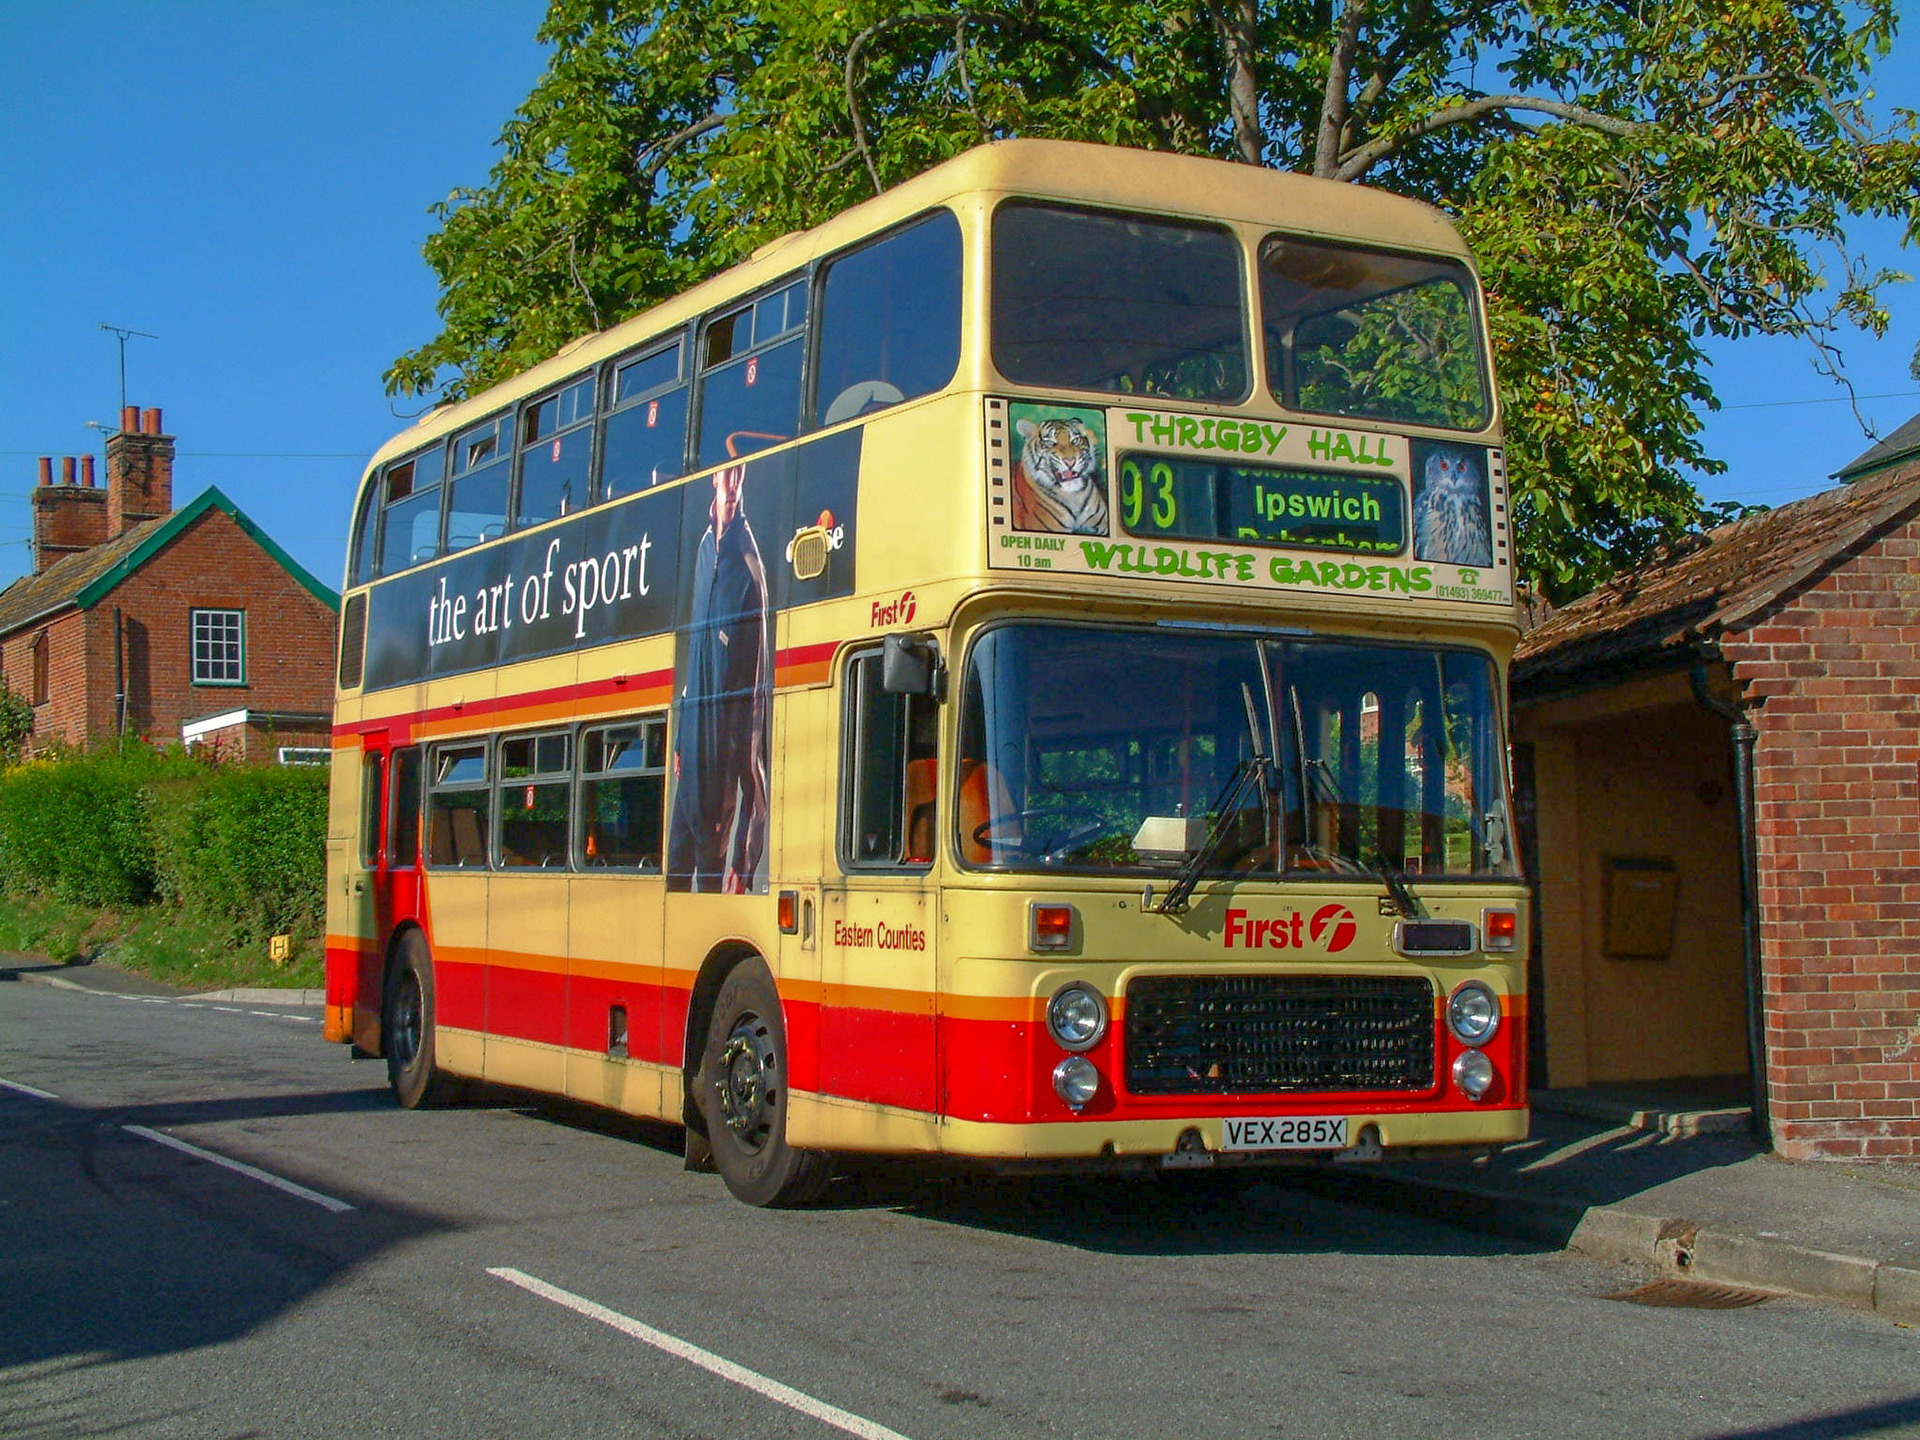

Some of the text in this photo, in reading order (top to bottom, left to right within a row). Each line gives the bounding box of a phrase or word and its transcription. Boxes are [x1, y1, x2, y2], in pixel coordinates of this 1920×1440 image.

[1125, 413, 1394, 467] THRIGBY HALL
[1121, 460, 1176, 528] 93
[1255, 485, 1381, 521] Ipswich
[1001, 535, 1066, 551] OPEN DAILY
[1017, 554, 1051, 568] 10 am
[1079, 541, 1433, 593] WILDLIFE GARDENS
[428, 532, 652, 646] the art of sport
[871, 600, 898, 628] First
[834, 920, 926, 951] Eastern Counties
[1224, 909, 1304, 948] First
[274, 940, 285, 955] H
[1227, 1120, 1342, 1144] VEX 285X
